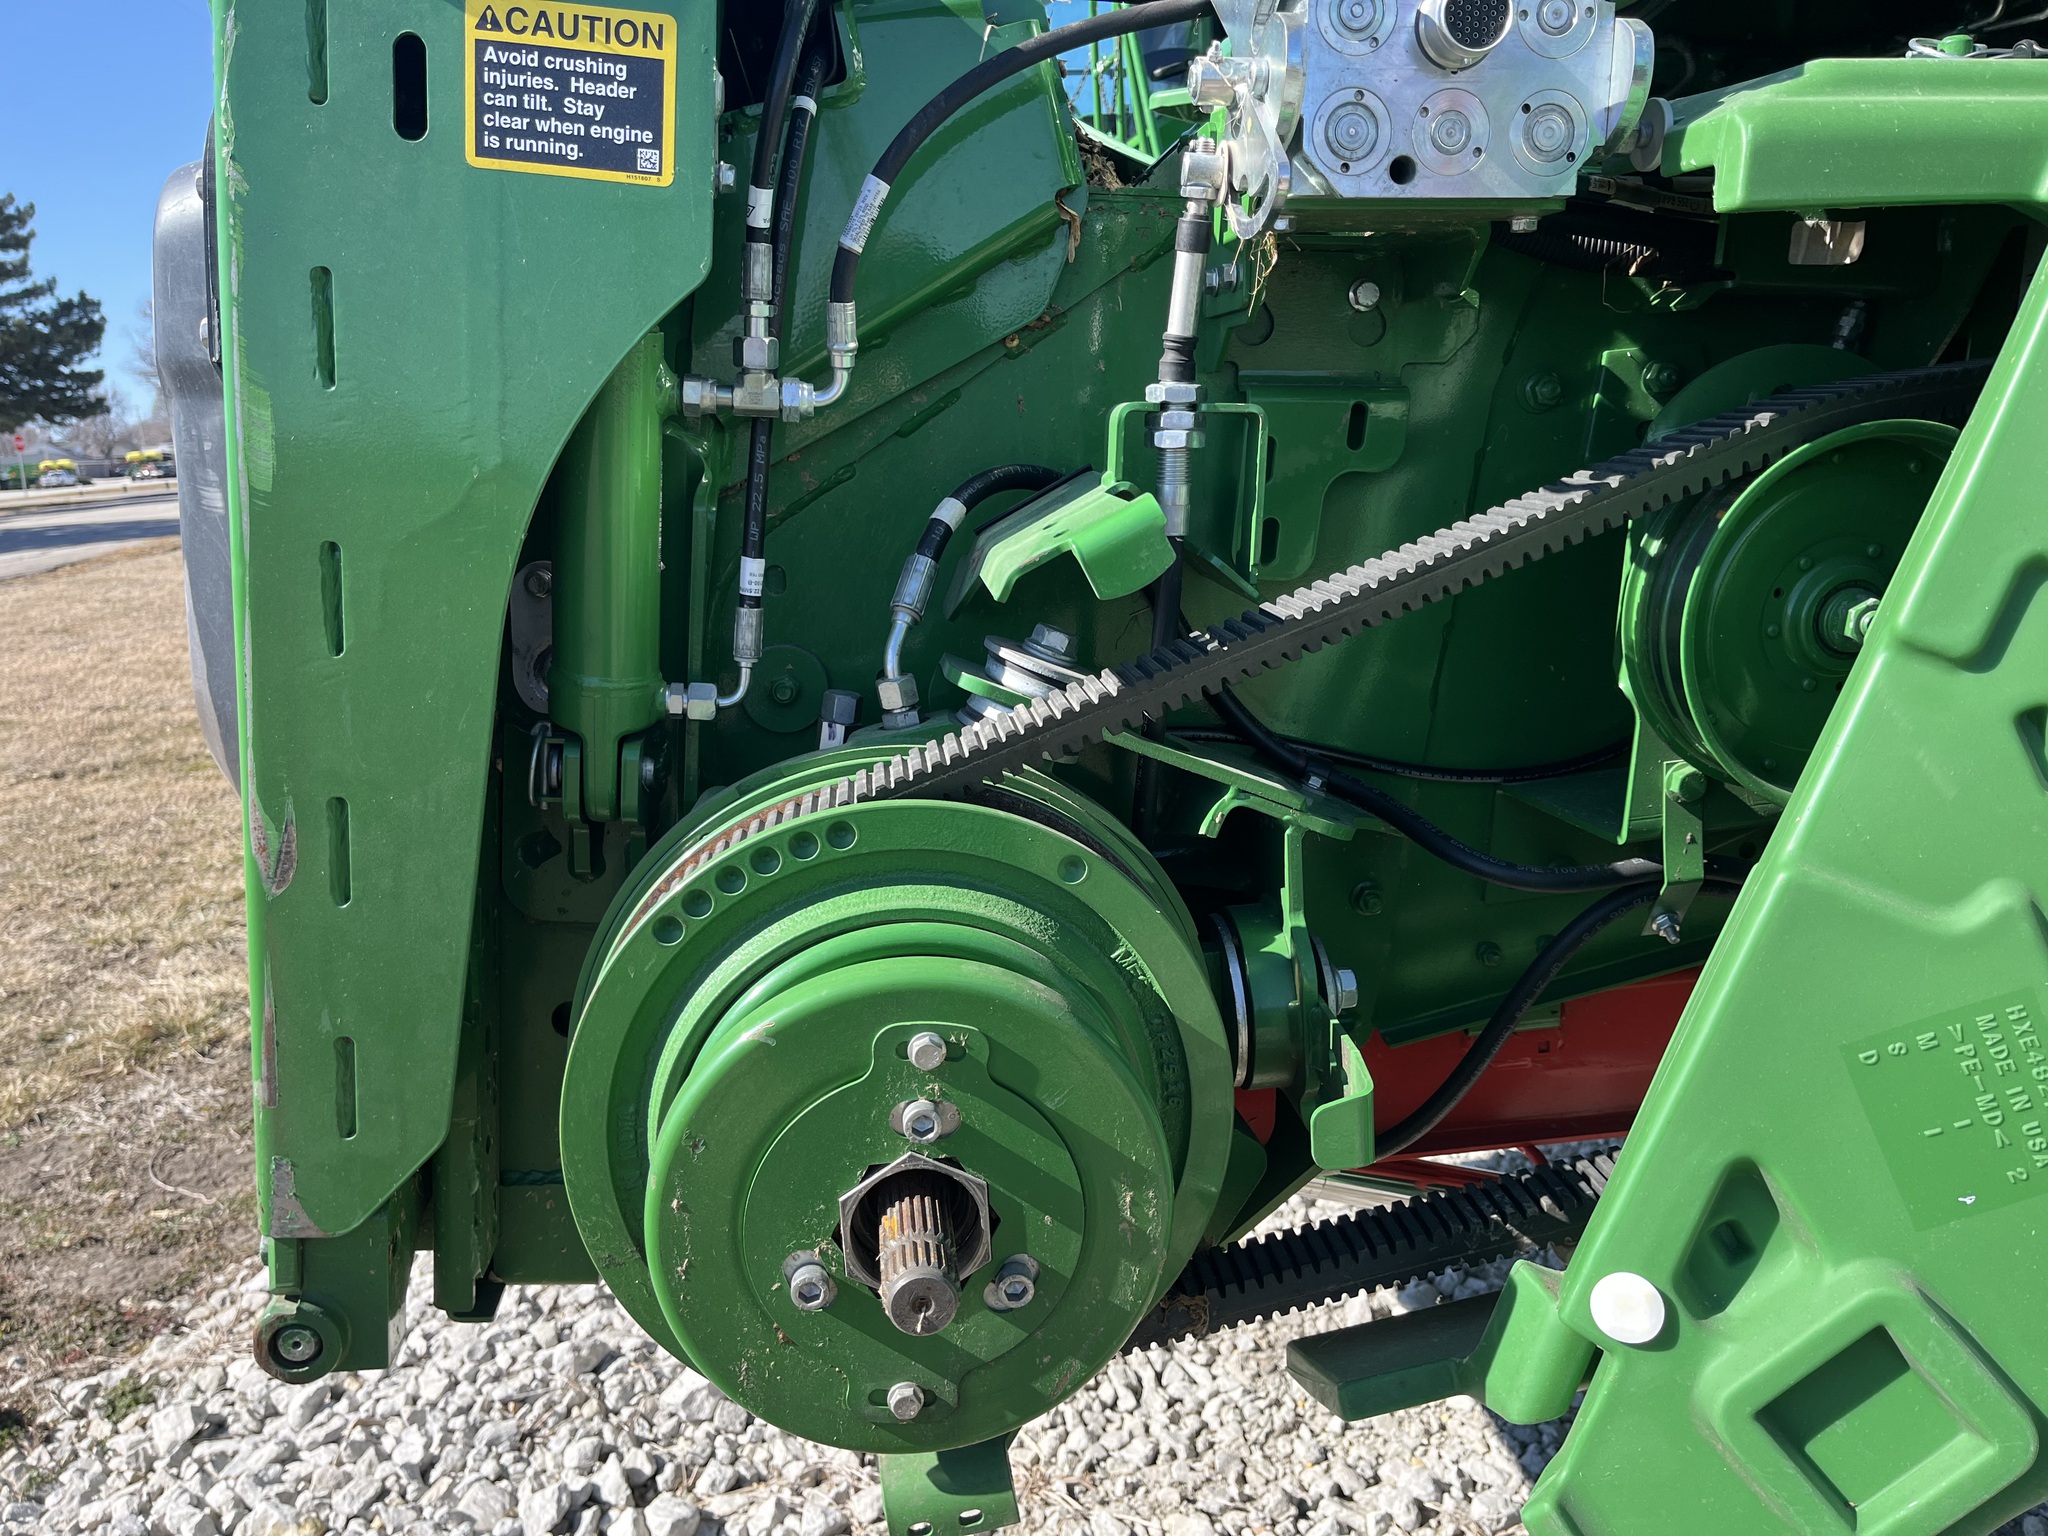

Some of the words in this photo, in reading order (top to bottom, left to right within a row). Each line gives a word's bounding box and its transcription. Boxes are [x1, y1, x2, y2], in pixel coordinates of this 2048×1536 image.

[505, 6, 664, 50] CAUTION
[483, 46, 539, 67] Avoid
[544, 55, 627, 81] crushing
[483, 67, 559, 91] injuries.
[570, 77, 637, 100] Header
[804, 77, 816, 95] EN
[483, 92, 517, 108] can
[522, 93, 553, 112] tilt.
[563, 97, 605, 120] Stay
[483, 113, 531, 130] clear
[535, 118, 585, 137] when
[590, 124, 654, 145] engine
[792, 118, 806, 150] R17
[483, 131, 500, 148] is
[505, 135, 584, 160] running.
[786, 159, 799, 188] 100
[779, 200, 793, 232] SAE
[756, 435, 767, 464] MPa
[753, 473, 763, 512] 22.5
[958, 480, 985, 502] MADE
[989, 470, 1004, 481] IN
[1008, 464, 1044, 475] ITALY
[750, 521, 759, 541] WP
[1516, 864, 1545, 874] SAE
[1888, 1042, 1908, 1057] S
[1916, 1031, 1939, 1051] M
[1858, 1049, 1880, 1066] D
[2005, 1004, 2048, 1108] HXE48
[1976, 1013, 2018, 1076] MADE
[2005, 1086, 2034, 1112] IN
[2021, 1120, 2048, 1169] USA
[2006, 1167, 2029, 1184] 2
